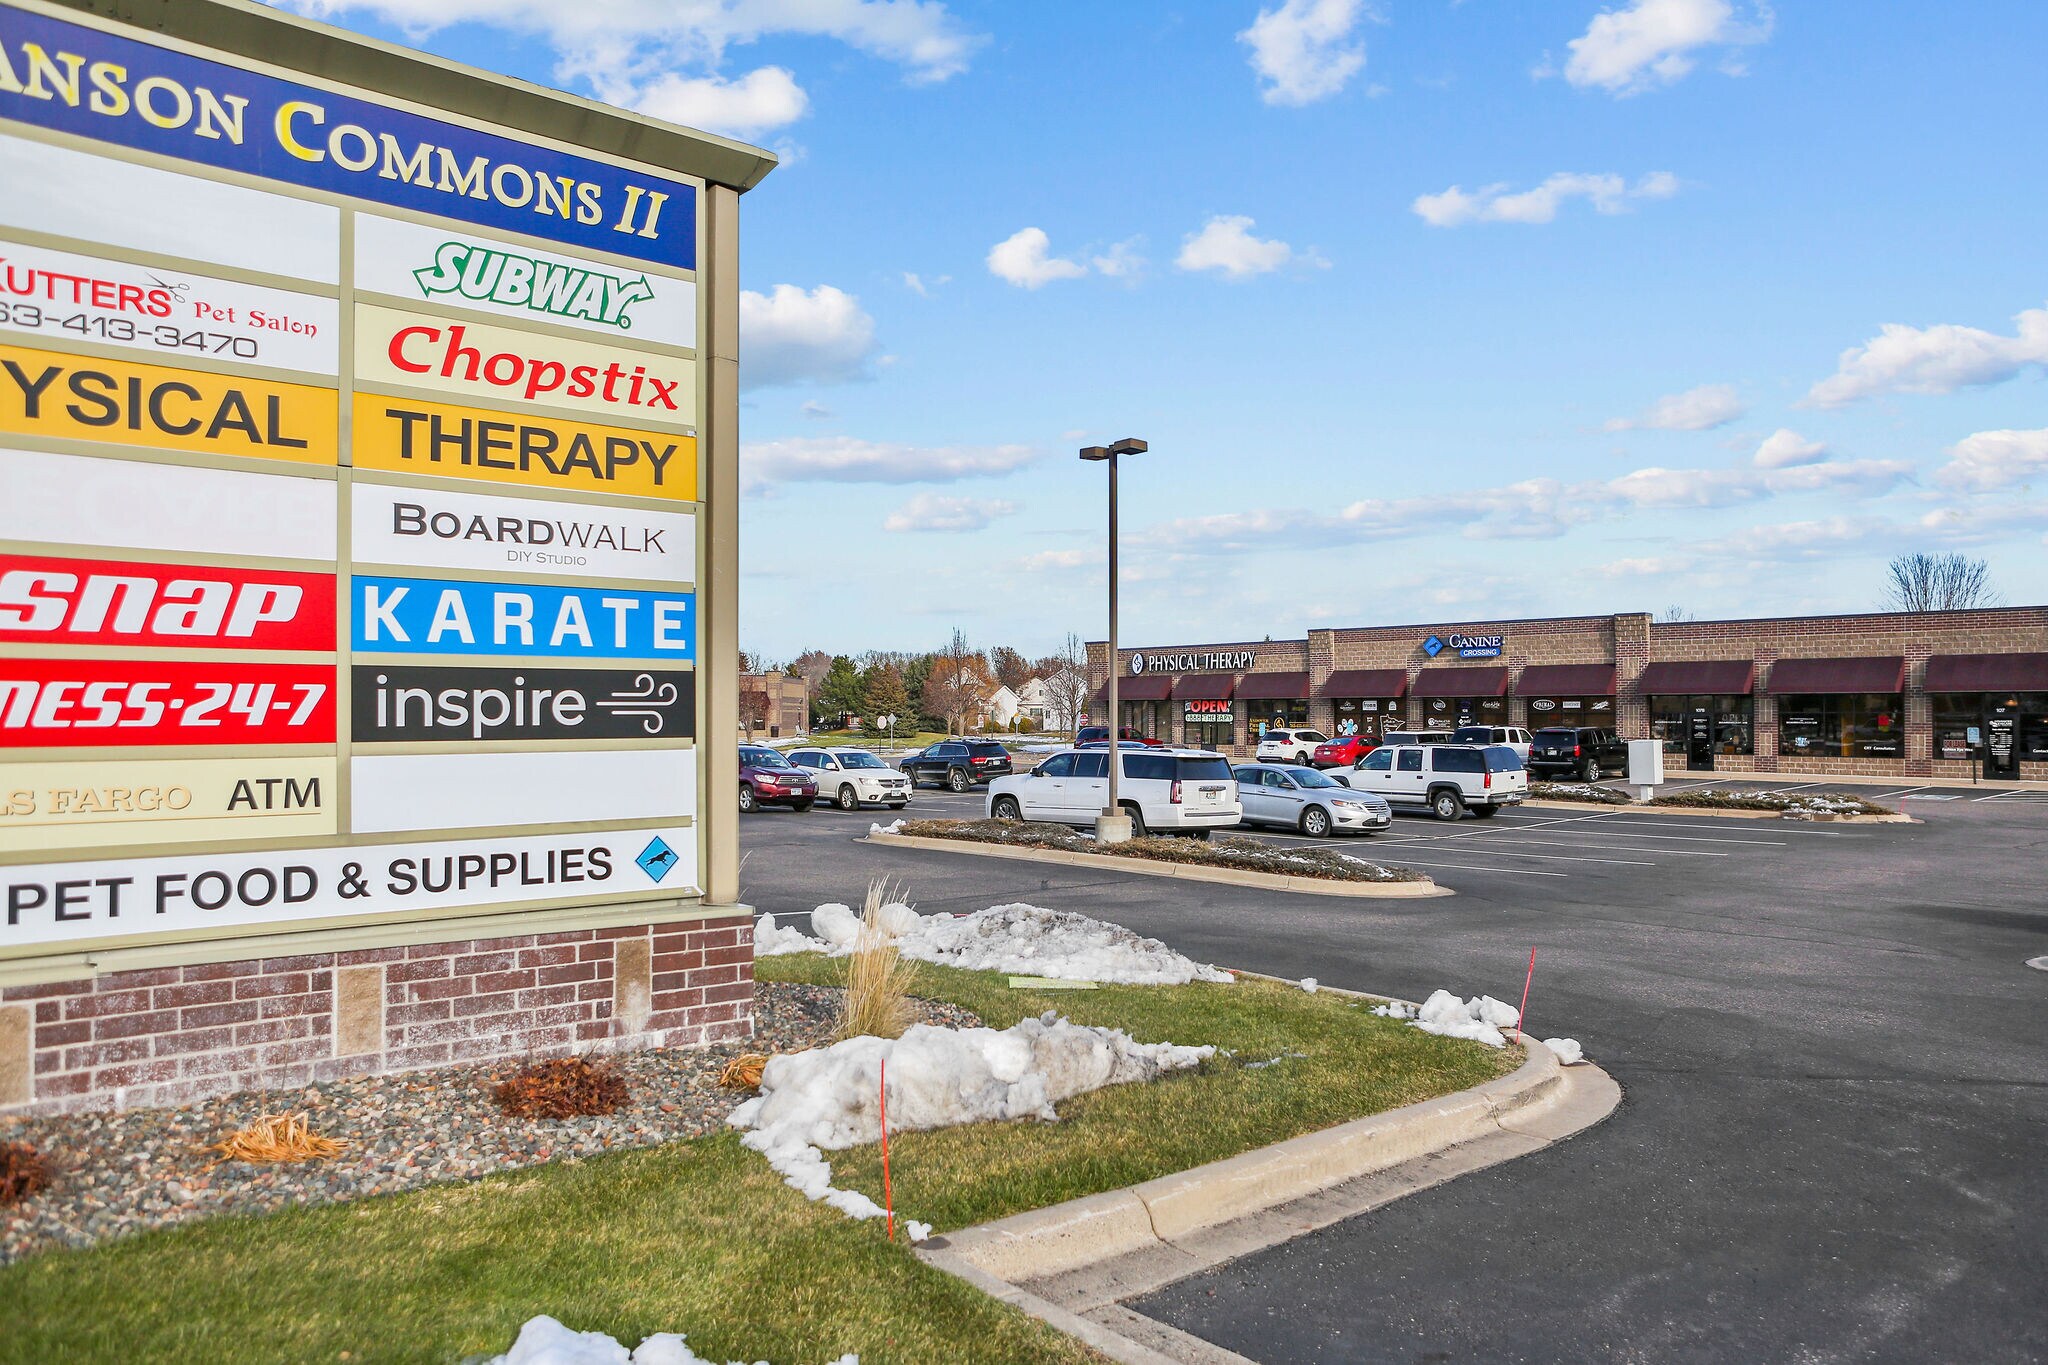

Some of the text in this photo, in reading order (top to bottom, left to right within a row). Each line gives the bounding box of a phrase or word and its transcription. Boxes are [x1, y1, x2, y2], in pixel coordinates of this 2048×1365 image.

[274, 101, 603, 226] COMMONS
[614, 185, 670, 240] II
[0, 257, 318, 339] UTTERS Pet Salon
[412, 241, 655, 329] SUBWAY
[388, 325, 680, 411] Chopstix
[1, 359, 309, 449] YSICAL
[385, 408, 679, 486] THERAPY
[392, 502, 667, 554] BOARDWALK
[507, 550, 532, 563] DIY
[364, 585, 687, 649] KARATE
[1449, 633, 1501, 648] CANINE
[1148, 651, 1256, 672] PHYSICAL THERAPY
[1463, 648, 1497, 656] CROSSING
[376, 673, 588, 739] inspire
[0, 777, 322, 816] S FARGO ATM
[7, 847, 614, 926] PET FOOD & SUPPLIES
